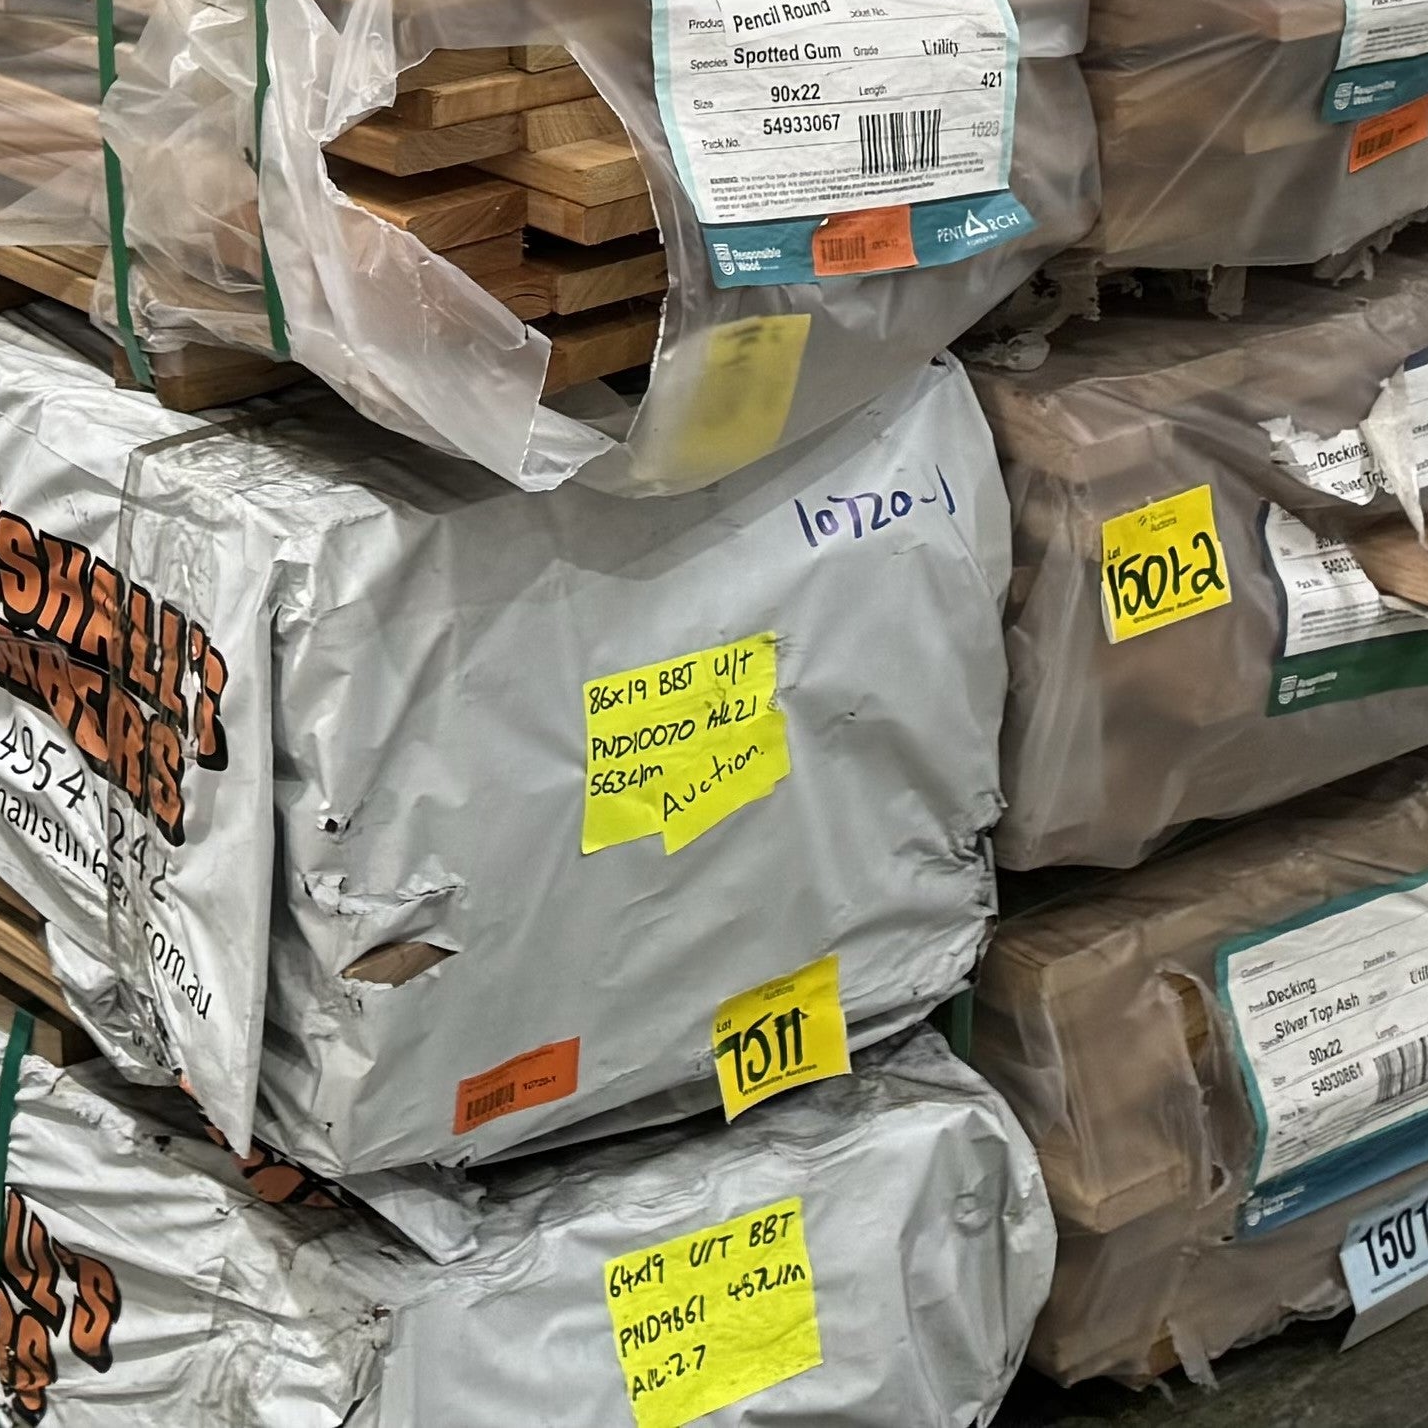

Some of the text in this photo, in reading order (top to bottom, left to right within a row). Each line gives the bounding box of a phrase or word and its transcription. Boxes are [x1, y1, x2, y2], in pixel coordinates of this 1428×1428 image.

[733, 11, 782, 33] Pencil
[734, 38, 961, 65] Spotted Gum Utility
[770, 71, 1003, 102] 90x22 421
[763, 114, 841, 135] 54933067
[1318, 440, 1368, 469] Decking
[589, 661, 697, 714] 86x19 BBT
[592, 719, 696, 761] PND10070
[0, 715, 88, 809] 4954
[1267, 976, 1317, 1005] Decking
[1310, 993, 1361, 1026] Top Ash
[610, 1253, 665, 1298] 64x19
[749, 1211, 795, 1247] BBT
